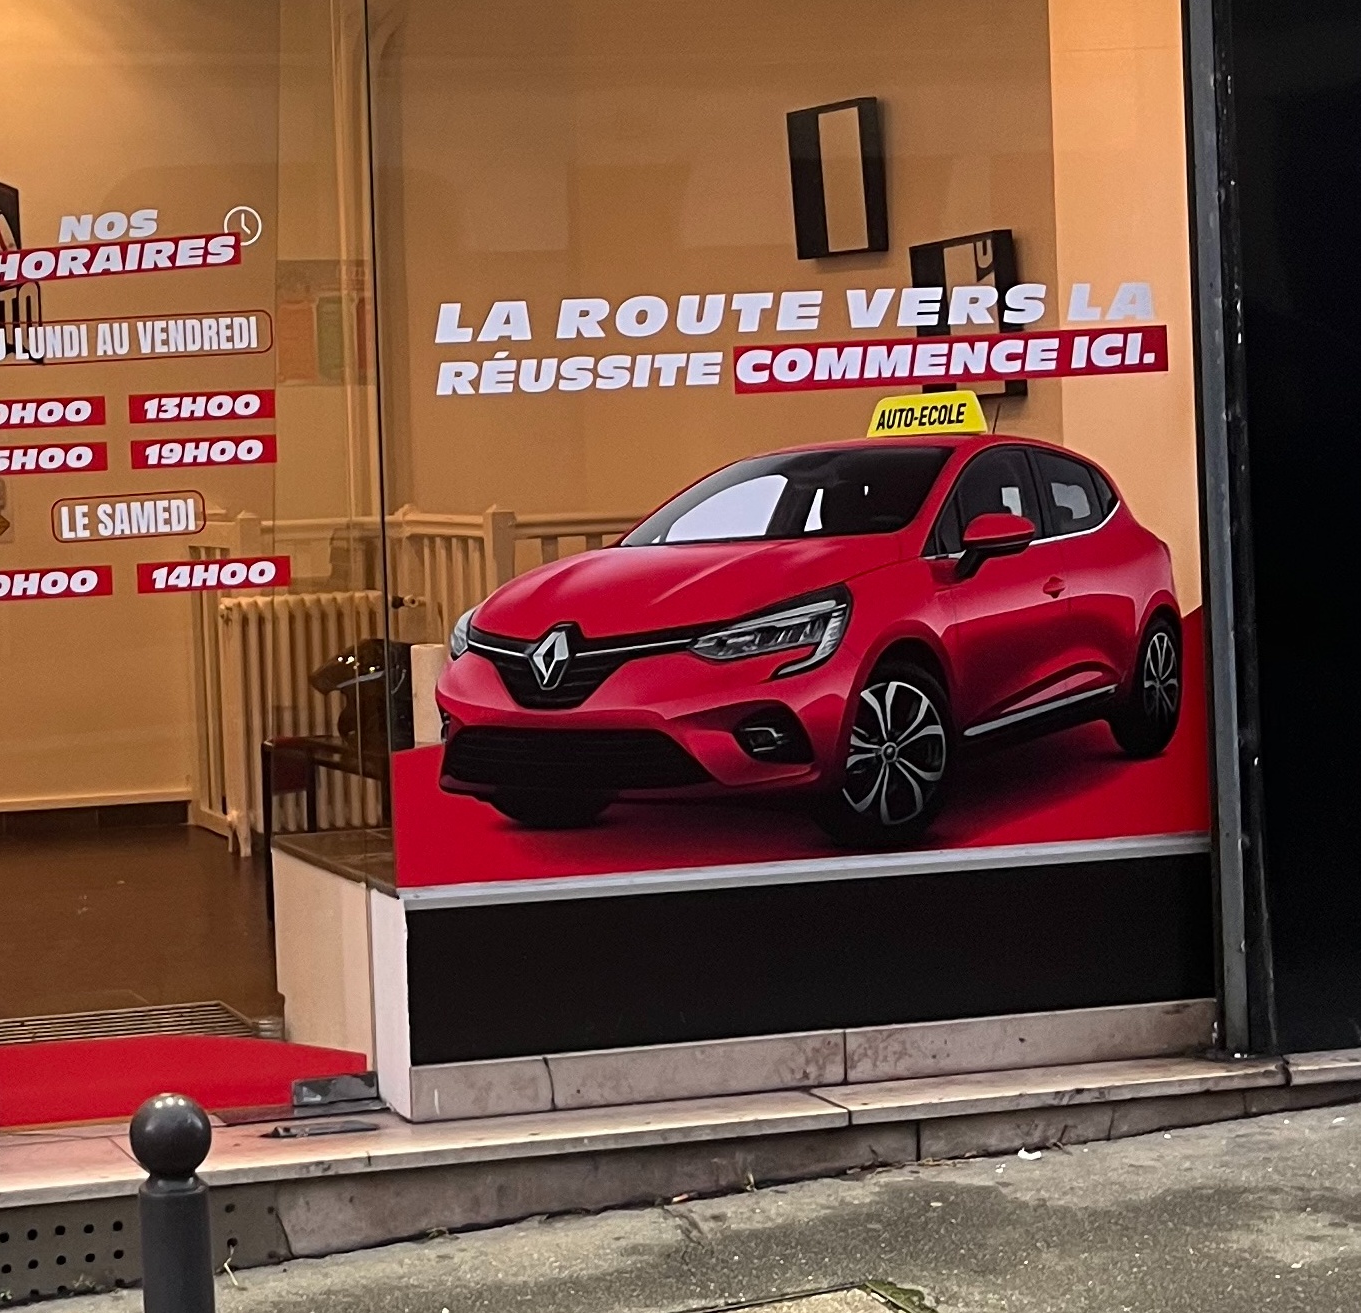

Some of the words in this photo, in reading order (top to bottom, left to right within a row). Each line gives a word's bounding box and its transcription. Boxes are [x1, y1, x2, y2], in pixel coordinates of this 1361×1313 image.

[58, 209, 158, 243] NOS
[435, 300, 532, 343] LA
[556, 290, 823, 340] ROUTE
[846, 283, 1047, 329] VERS
[1067, 282, 1155, 323] LA
[15, 323, 88, 360] LUNDI
[96, 322, 129, 356] AU
[136, 316, 258, 355] VENDREDI
[436, 351, 724, 396] RÉUSSITE
[736, 337, 1059, 385] COMMENCE
[1071, 332, 1156, 369] ICI.
[875, 402, 967, 432] AUTO-ECOLE
[60, 504, 90, 538] LE
[98, 498, 195, 537] SAMEDI
